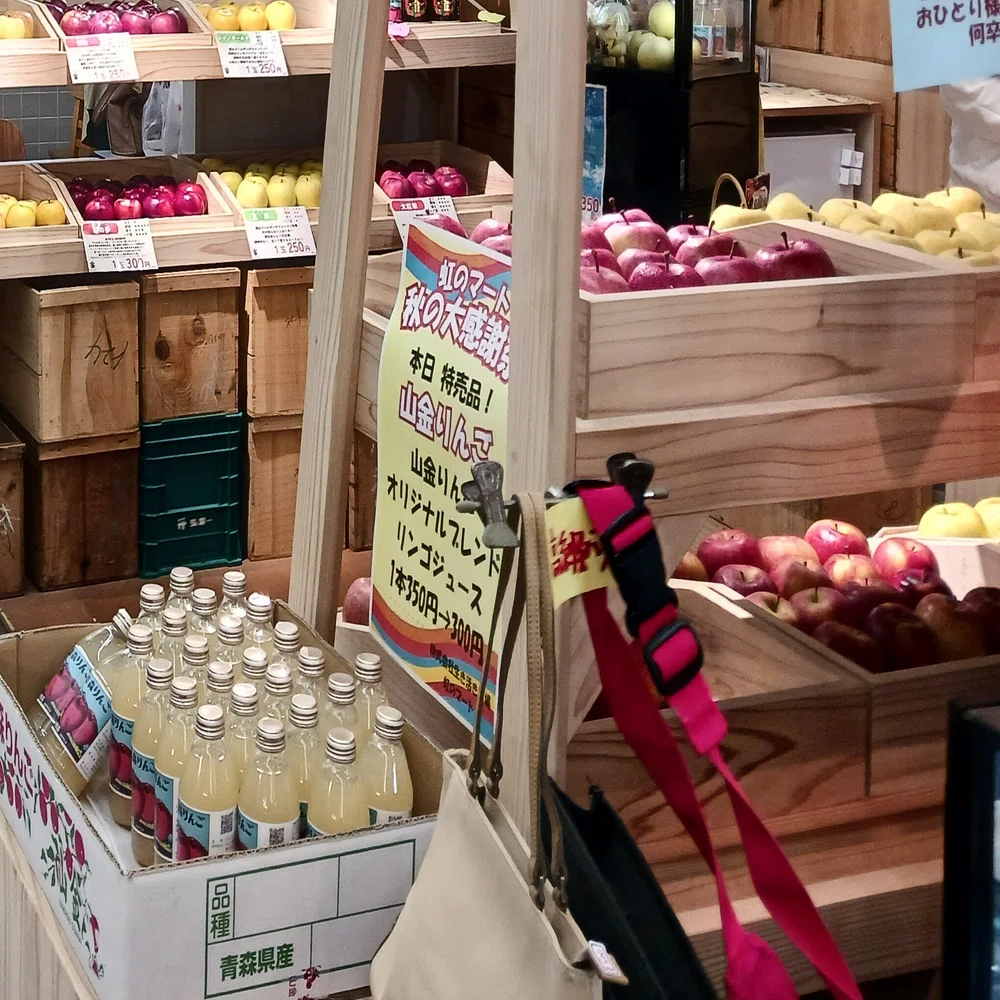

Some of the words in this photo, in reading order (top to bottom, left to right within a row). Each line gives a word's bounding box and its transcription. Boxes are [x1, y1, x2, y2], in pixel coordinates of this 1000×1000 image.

[438, 258, 511, 313] 虹のマート
[409, 346, 435, 383] 本日
[399, 381, 494, 465] 山金りんご
[411, 448, 467, 501] 山金りん
[387, 473, 500, 577] オリジナルブレンド
[397, 521, 483, 616] リンゴジュース
[210, 882, 231, 939] 品種
[219, 943, 294, 982] 青森県産
